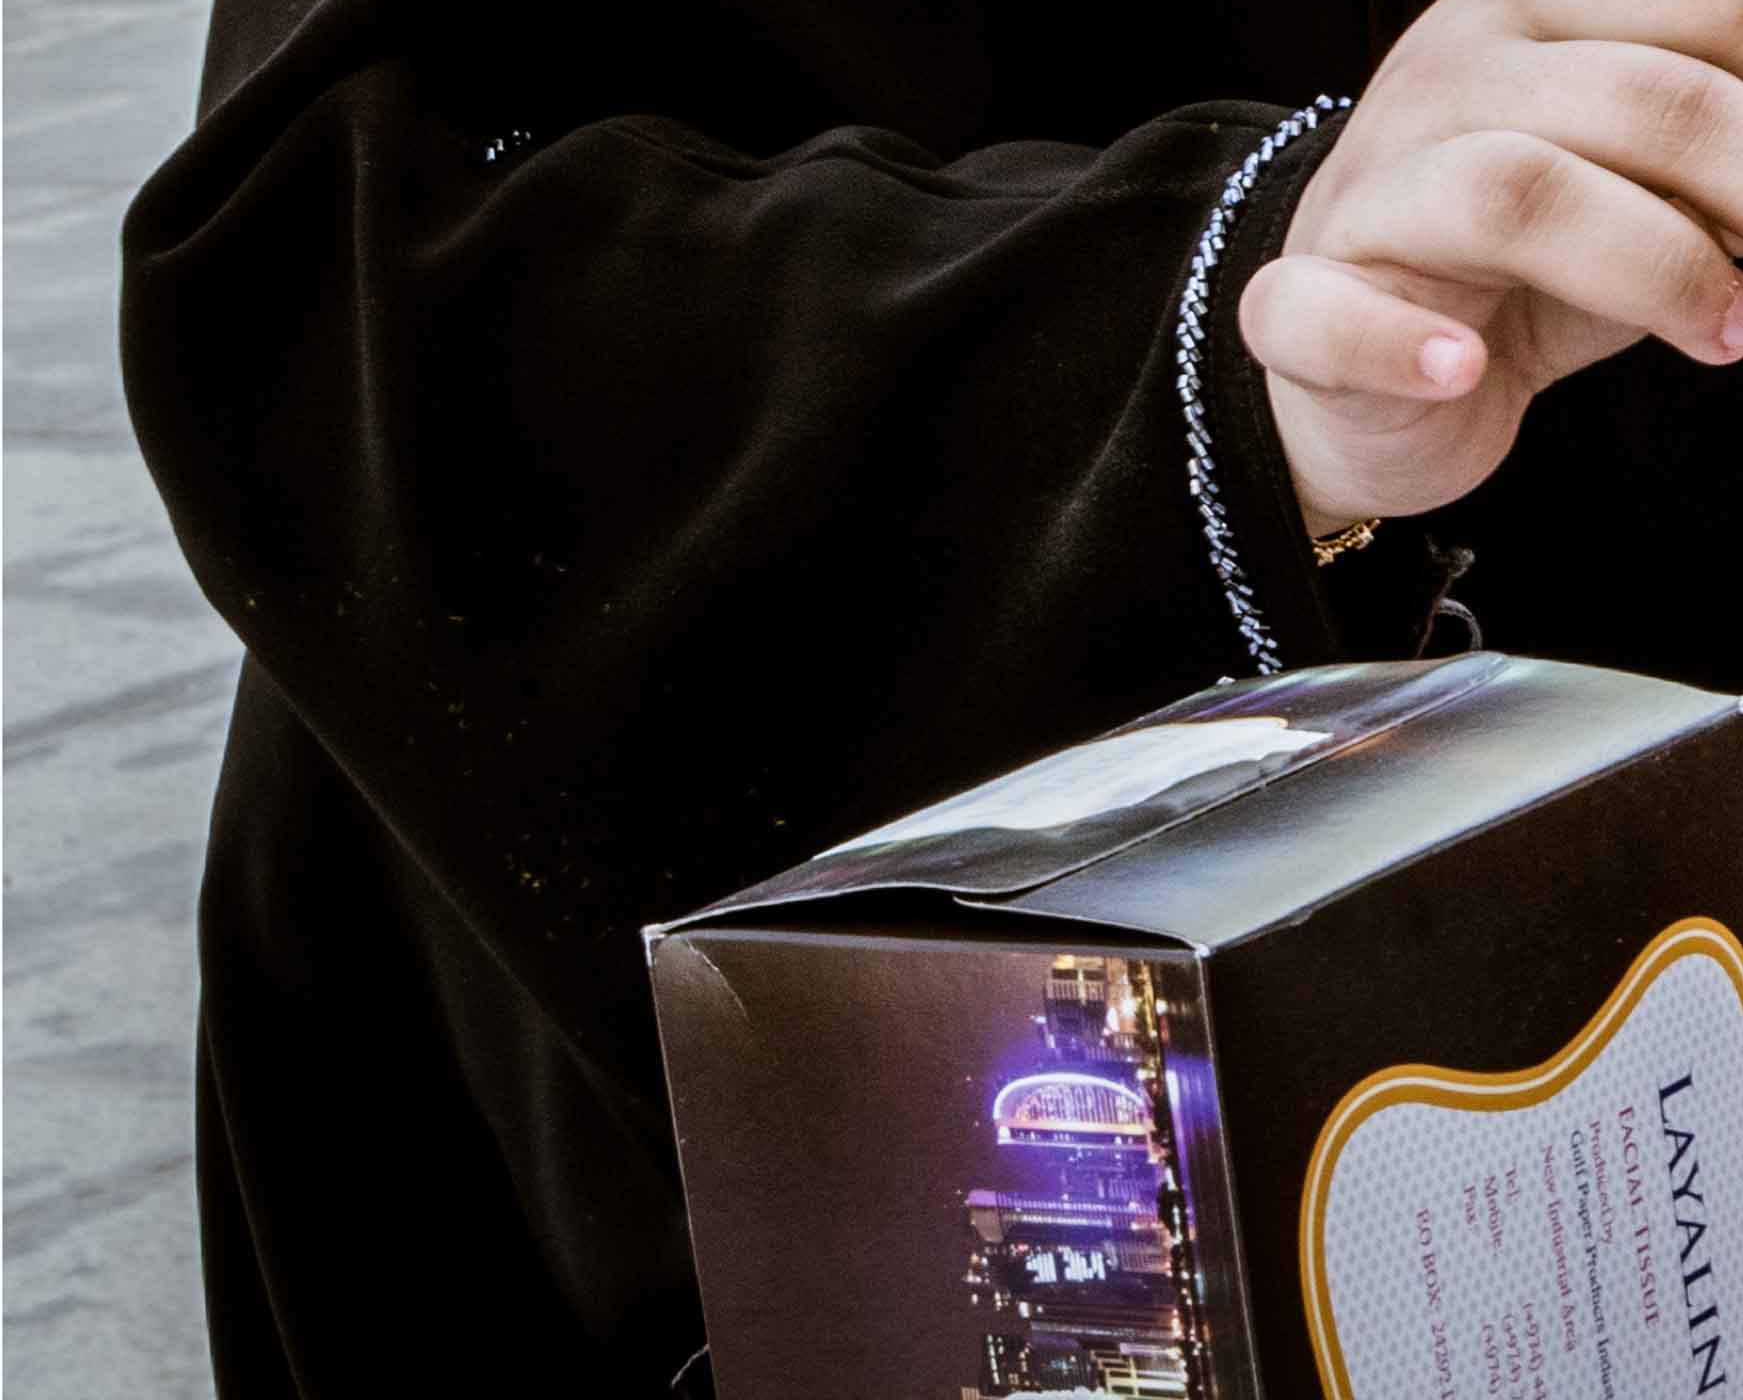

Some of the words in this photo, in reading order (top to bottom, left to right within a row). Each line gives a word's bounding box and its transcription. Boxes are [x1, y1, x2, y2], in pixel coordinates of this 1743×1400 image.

[1543, 1145, 1557, 1193] New
[1570, 1130, 1588, 1176] Gulf
[1577, 1182, 1594, 1240] Paper
[1619, 1106, 1643, 1207] FACIAL
[1633, 1225, 1660, 1328] TISSUE
[1547, 1199, 1573, 1297] Industrial
[1584, 1245, 1606, 1333] Products
[1560, 1304, 1576, 1353] Area
